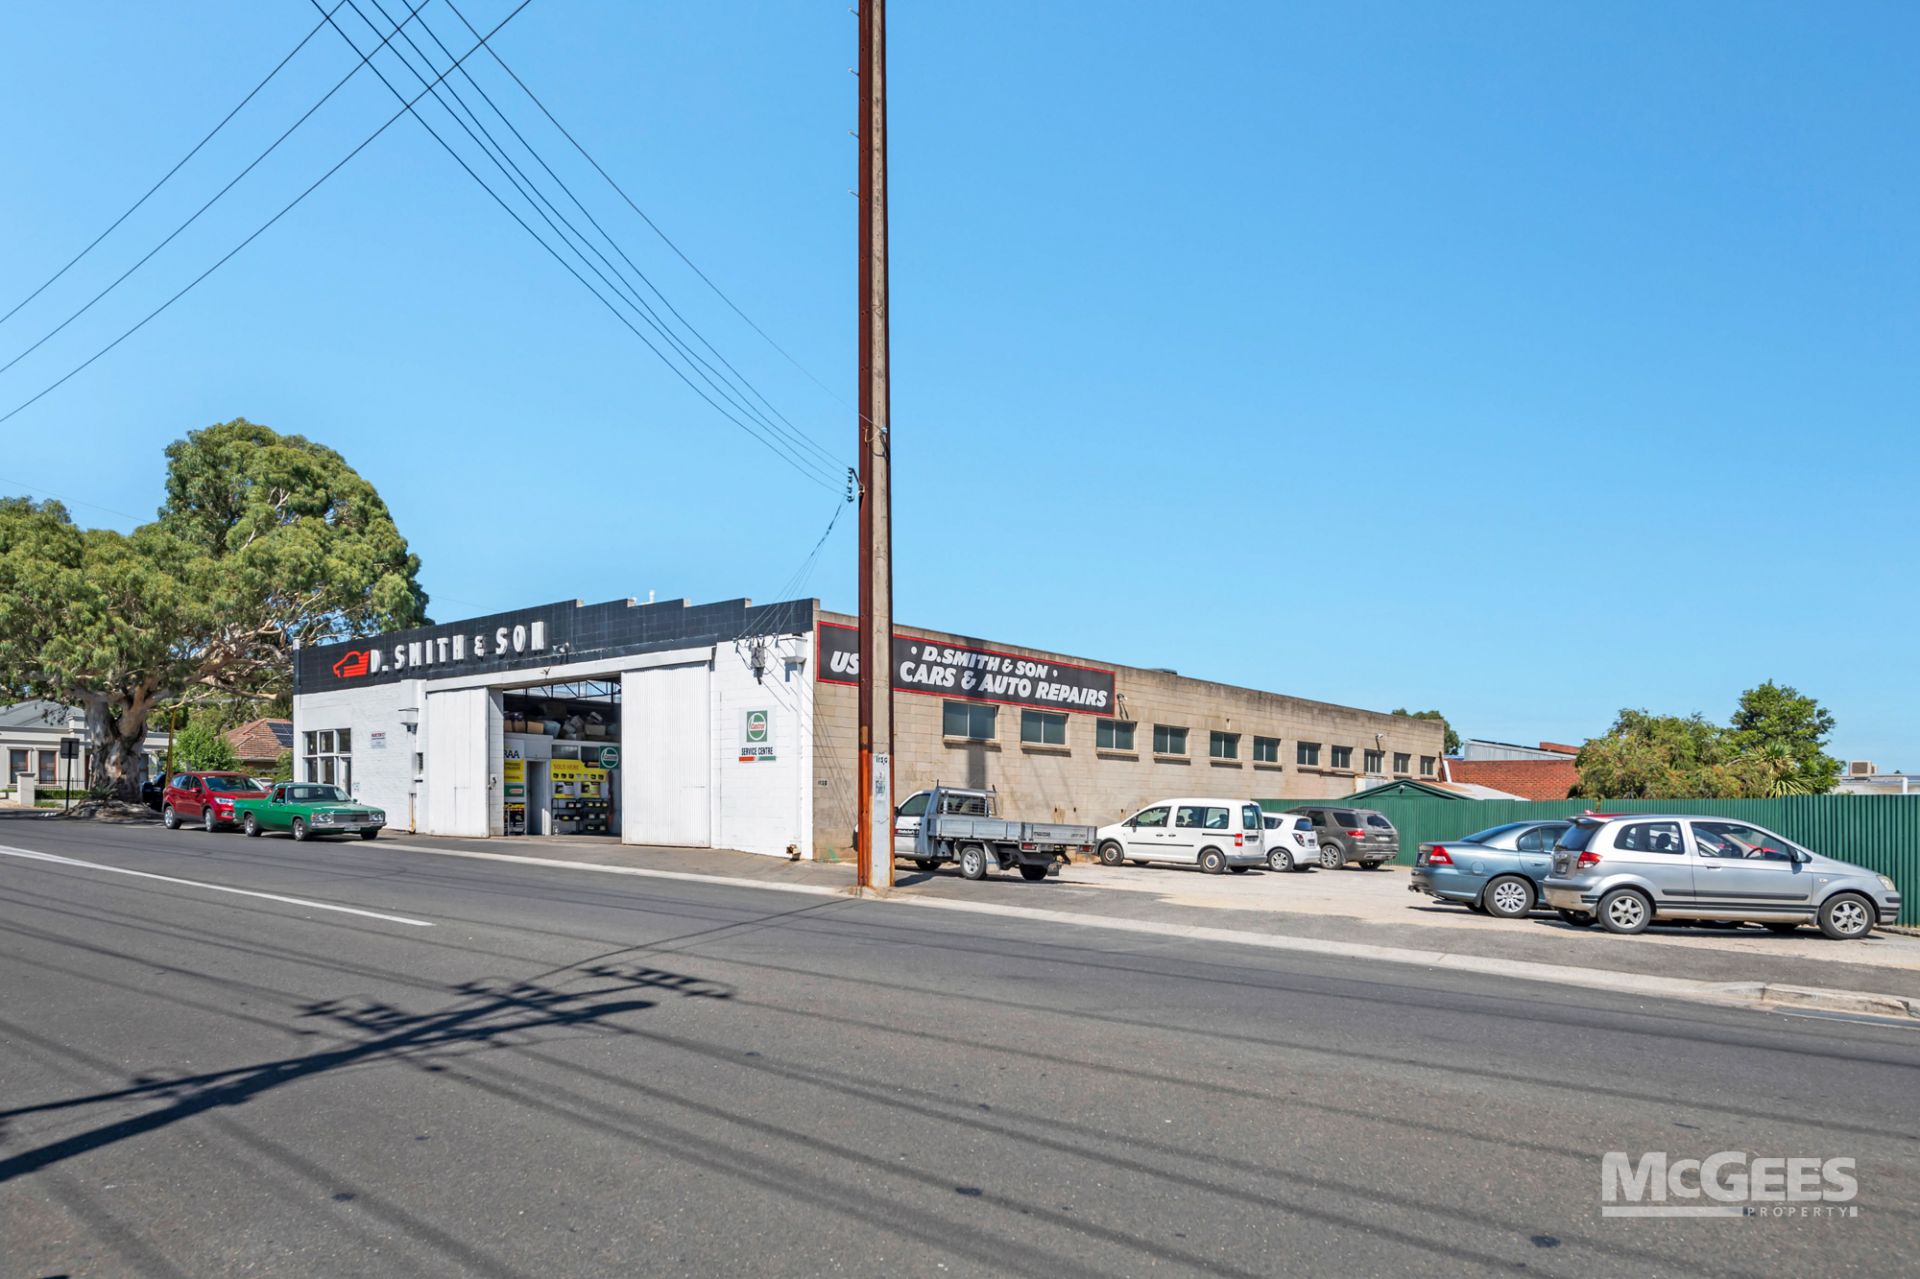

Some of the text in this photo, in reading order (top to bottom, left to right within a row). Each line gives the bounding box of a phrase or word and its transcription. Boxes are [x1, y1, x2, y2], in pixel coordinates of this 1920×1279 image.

[370, 621, 545, 673] D. SMITH & SON
[830, 650, 1108, 707] US CARS & AUTO REPAIRS
[1001, 659, 1013, 673] &
[1015, 661, 1049, 679] SON
[741, 746, 773, 755] SERVICE CENTRE
